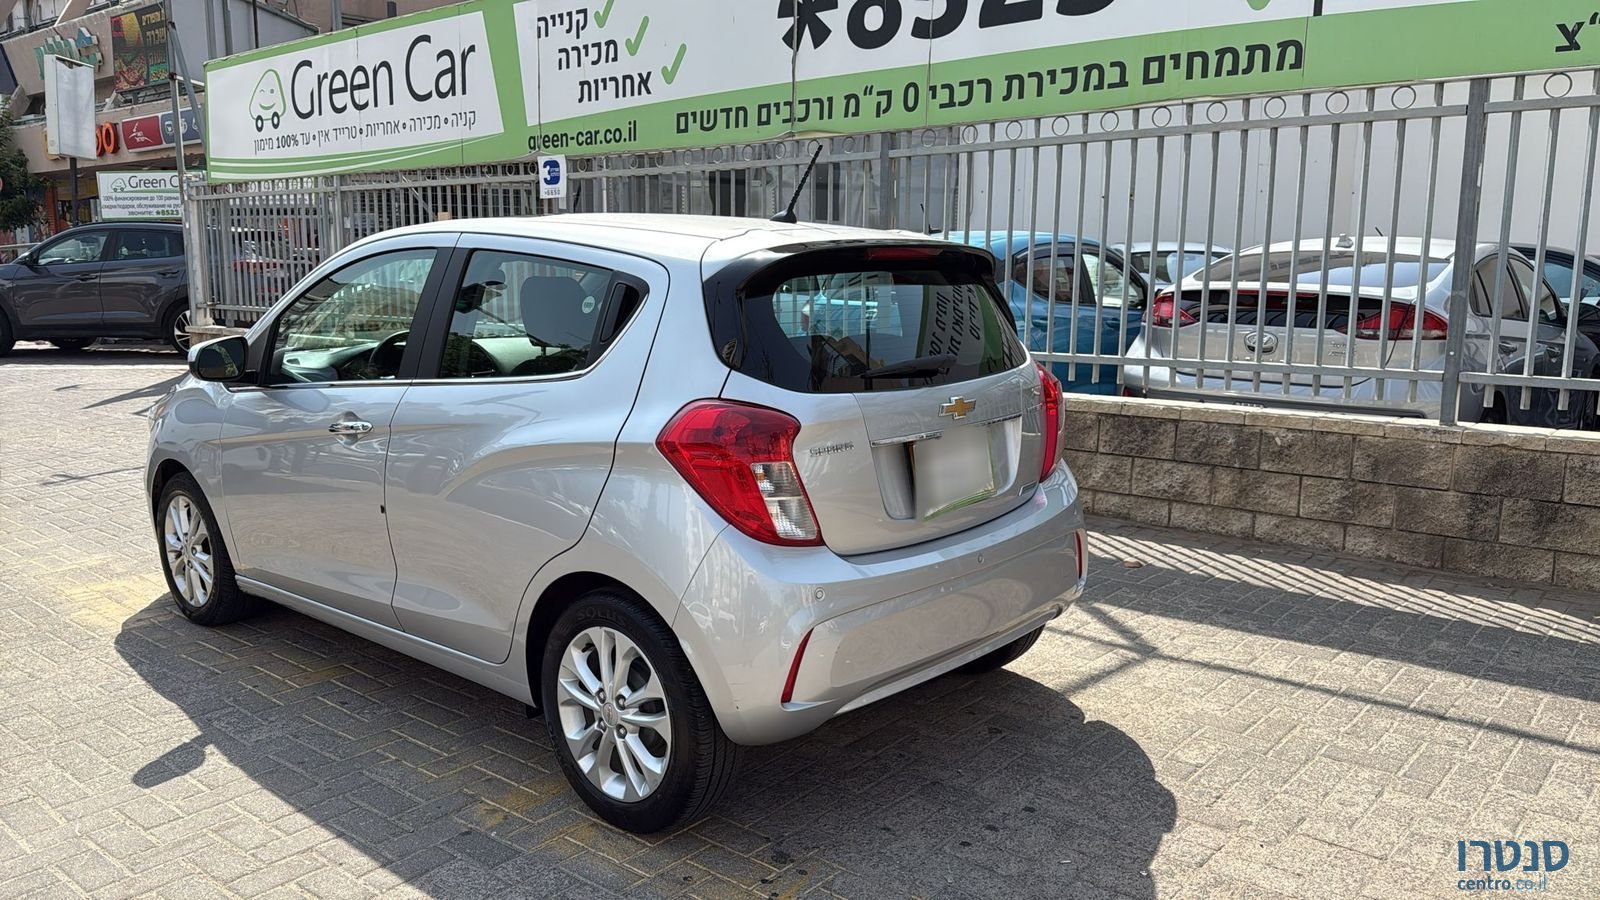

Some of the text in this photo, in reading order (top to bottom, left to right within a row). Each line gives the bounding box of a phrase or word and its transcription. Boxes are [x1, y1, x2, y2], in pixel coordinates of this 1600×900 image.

[536, 8, 588, 39] קנייה
[558, 39, 618, 70] מכירה
[1142, 39, 1304, 86] מתמחים
[290, 34, 476, 119] Green Car
[577, 71, 652, 104] אחריות
[1002, 60, 1129, 102] במכירת
[902, 81, 920, 113] 0
[928, 77, 993, 110] רכבי
[676, 106, 748, 134] חדשים
[757, 96, 833, 126] ורכבים
[254, 110, 476, 155] קניה מכירה אחריות טרייד אין עד 100% מימון
[528, 120, 637, 153] green-car.co.il
[128, 175, 179, 189] Green C
